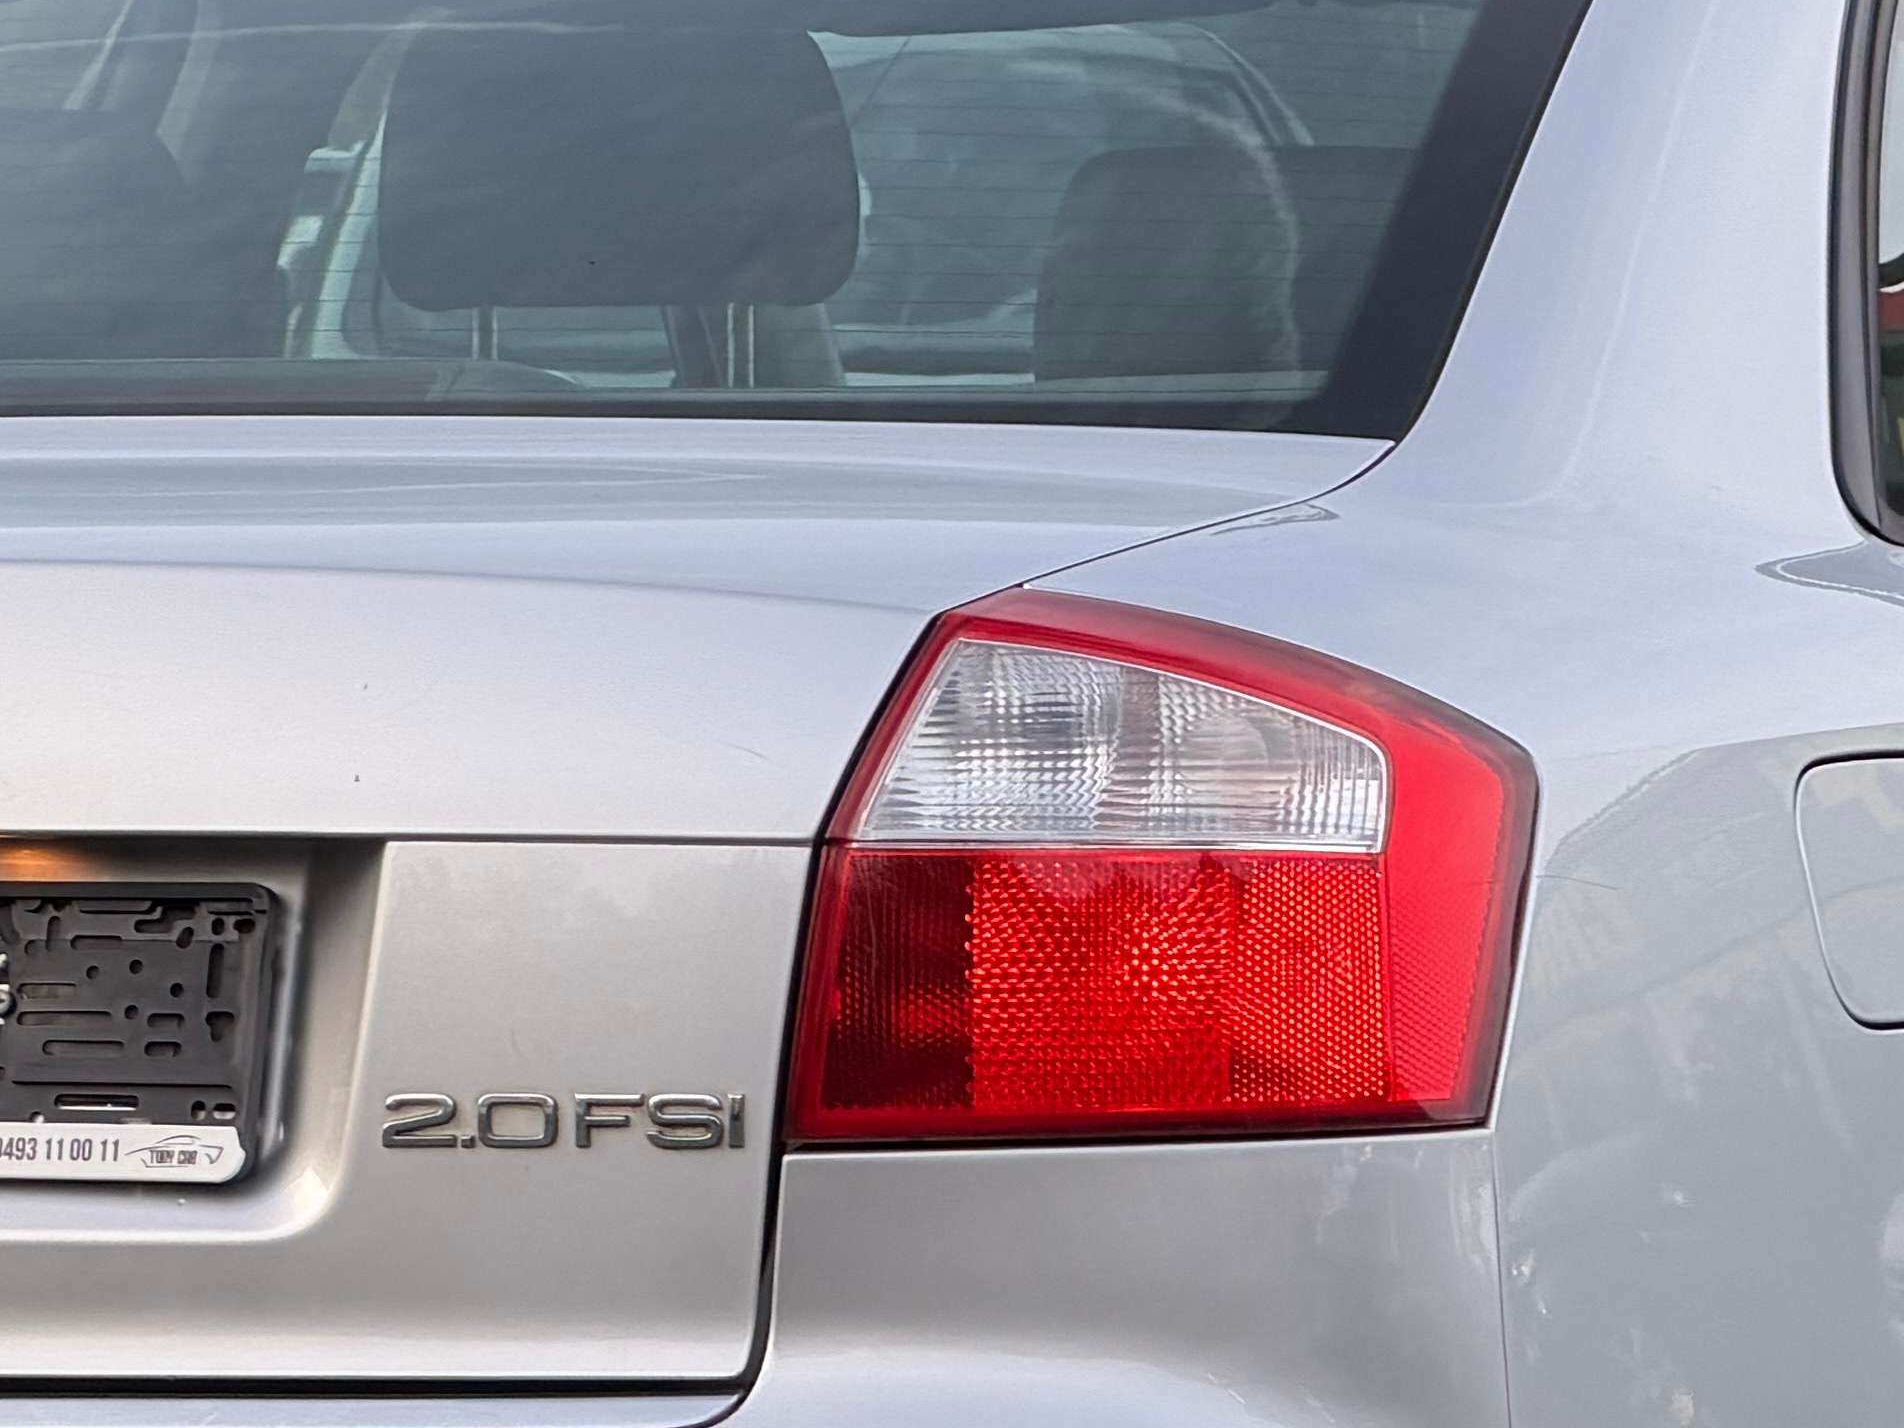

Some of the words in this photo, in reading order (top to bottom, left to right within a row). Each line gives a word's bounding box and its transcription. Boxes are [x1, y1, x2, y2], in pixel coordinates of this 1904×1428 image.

[45, 1137, 65, 1161] 11
[69, 1138, 93, 1162] 00
[100, 1138, 120, 1163] 11
